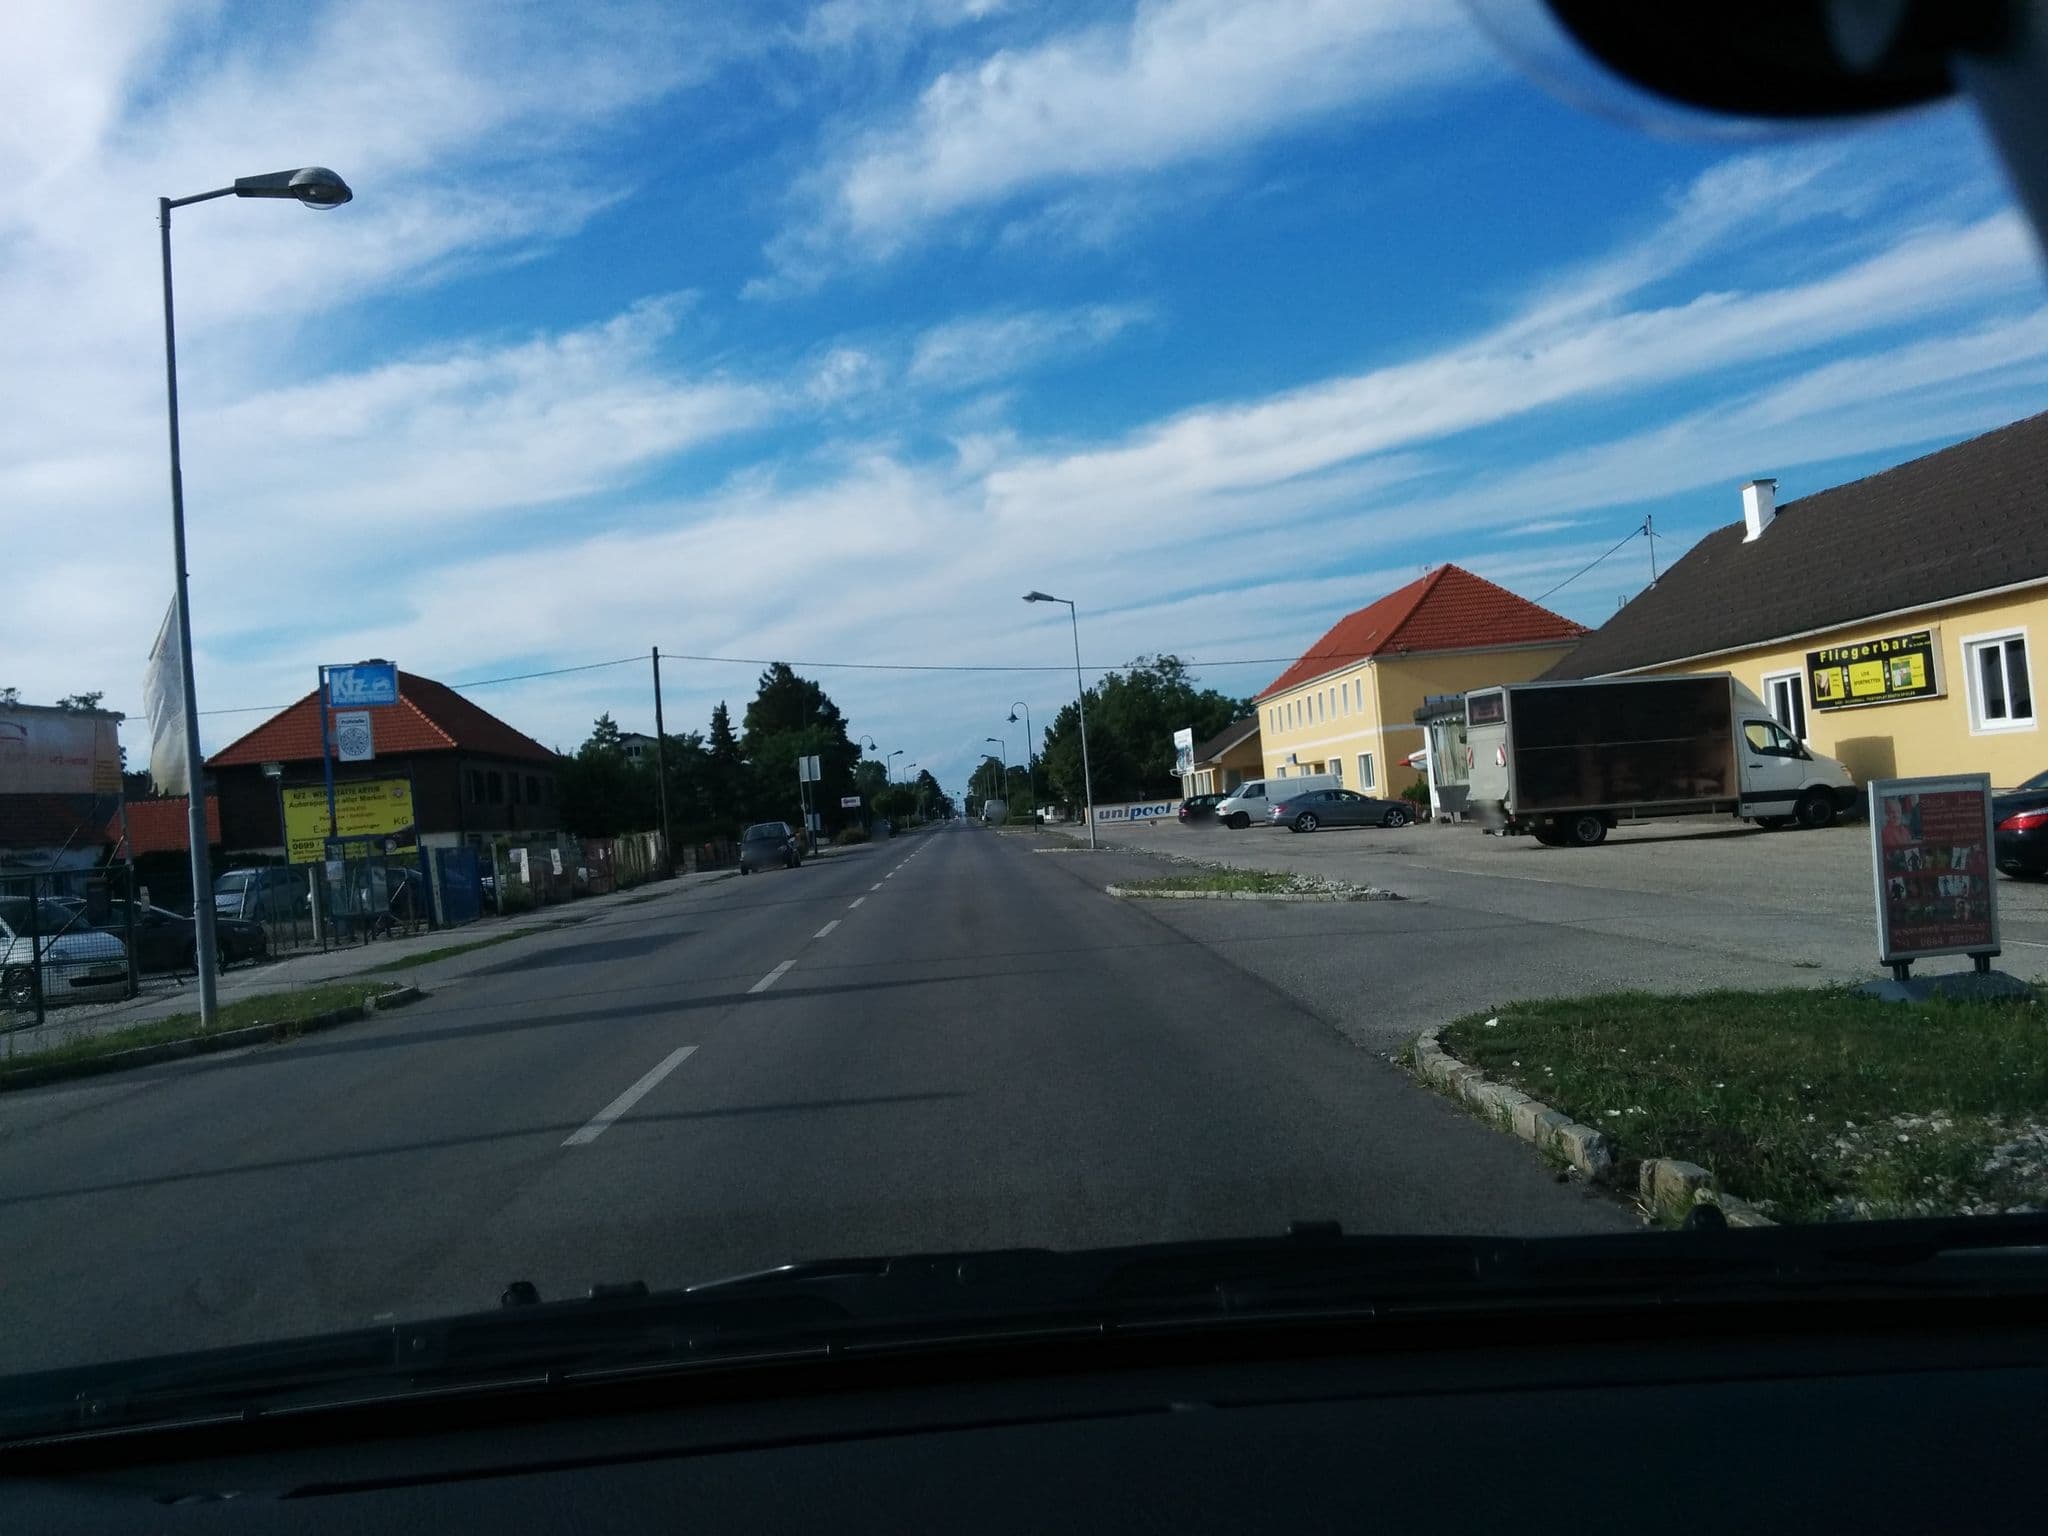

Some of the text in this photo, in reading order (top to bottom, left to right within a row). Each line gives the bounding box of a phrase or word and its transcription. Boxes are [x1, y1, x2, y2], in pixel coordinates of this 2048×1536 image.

[1819, 639, 1908, 662] Fliegerbar
[1099, 803, 1171, 820] unipool
[393, 816, 409, 826] KG
